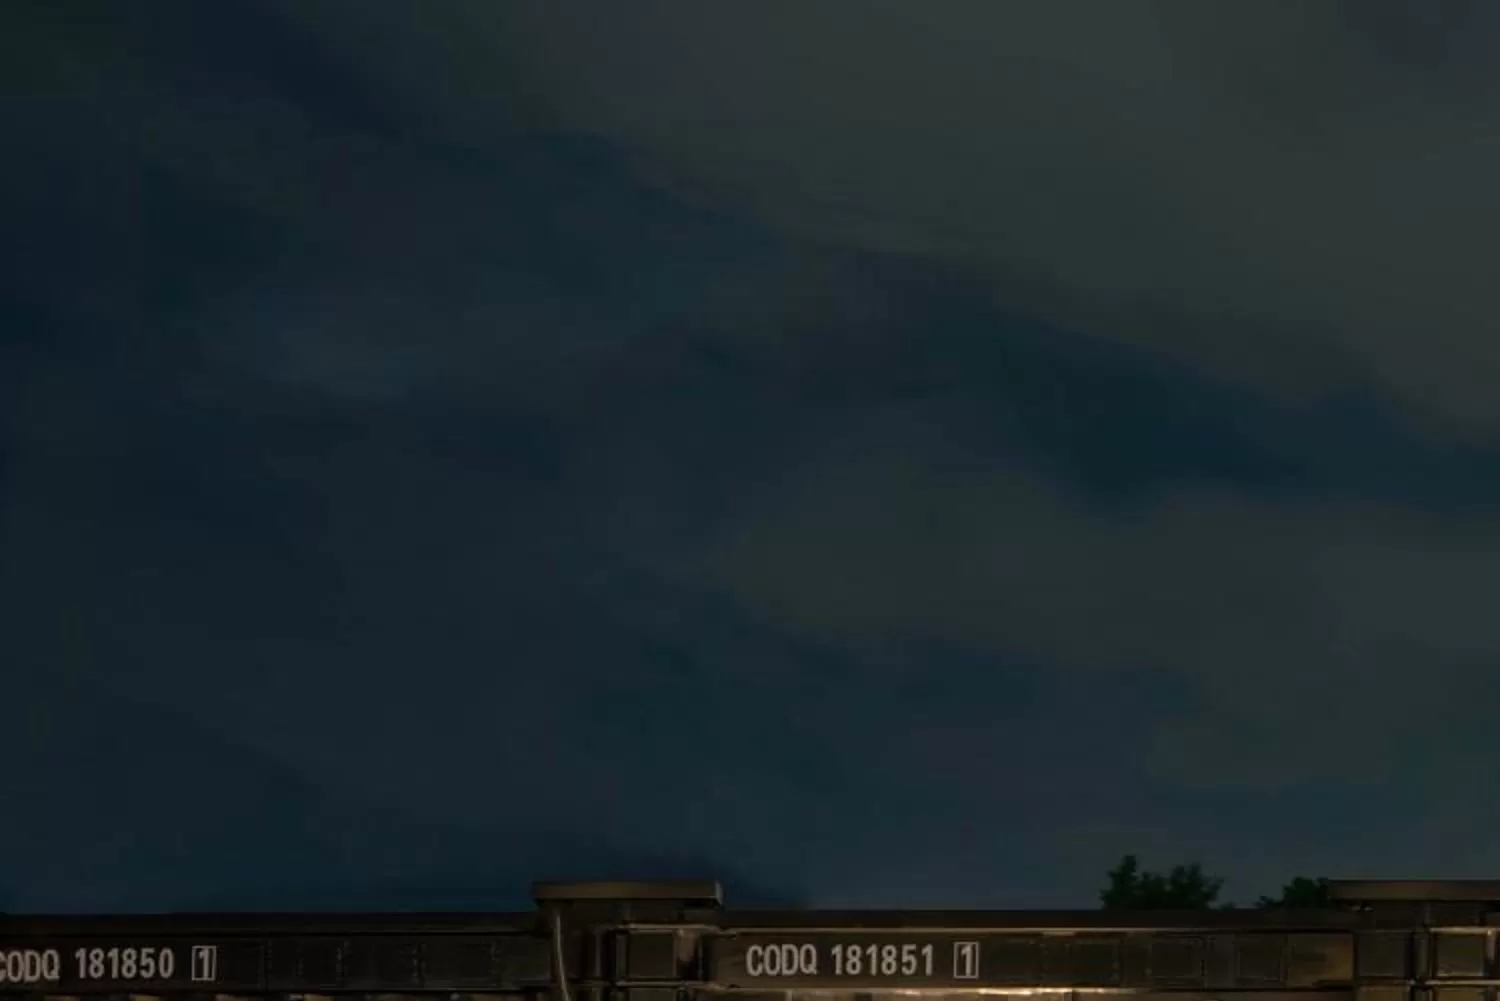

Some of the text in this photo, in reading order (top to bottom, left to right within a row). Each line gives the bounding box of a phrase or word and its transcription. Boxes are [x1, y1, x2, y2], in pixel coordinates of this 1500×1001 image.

[75, 947, 175, 979] 181850
[746, 943, 817, 976] CODQ
[831, 943, 934, 976] 181851
